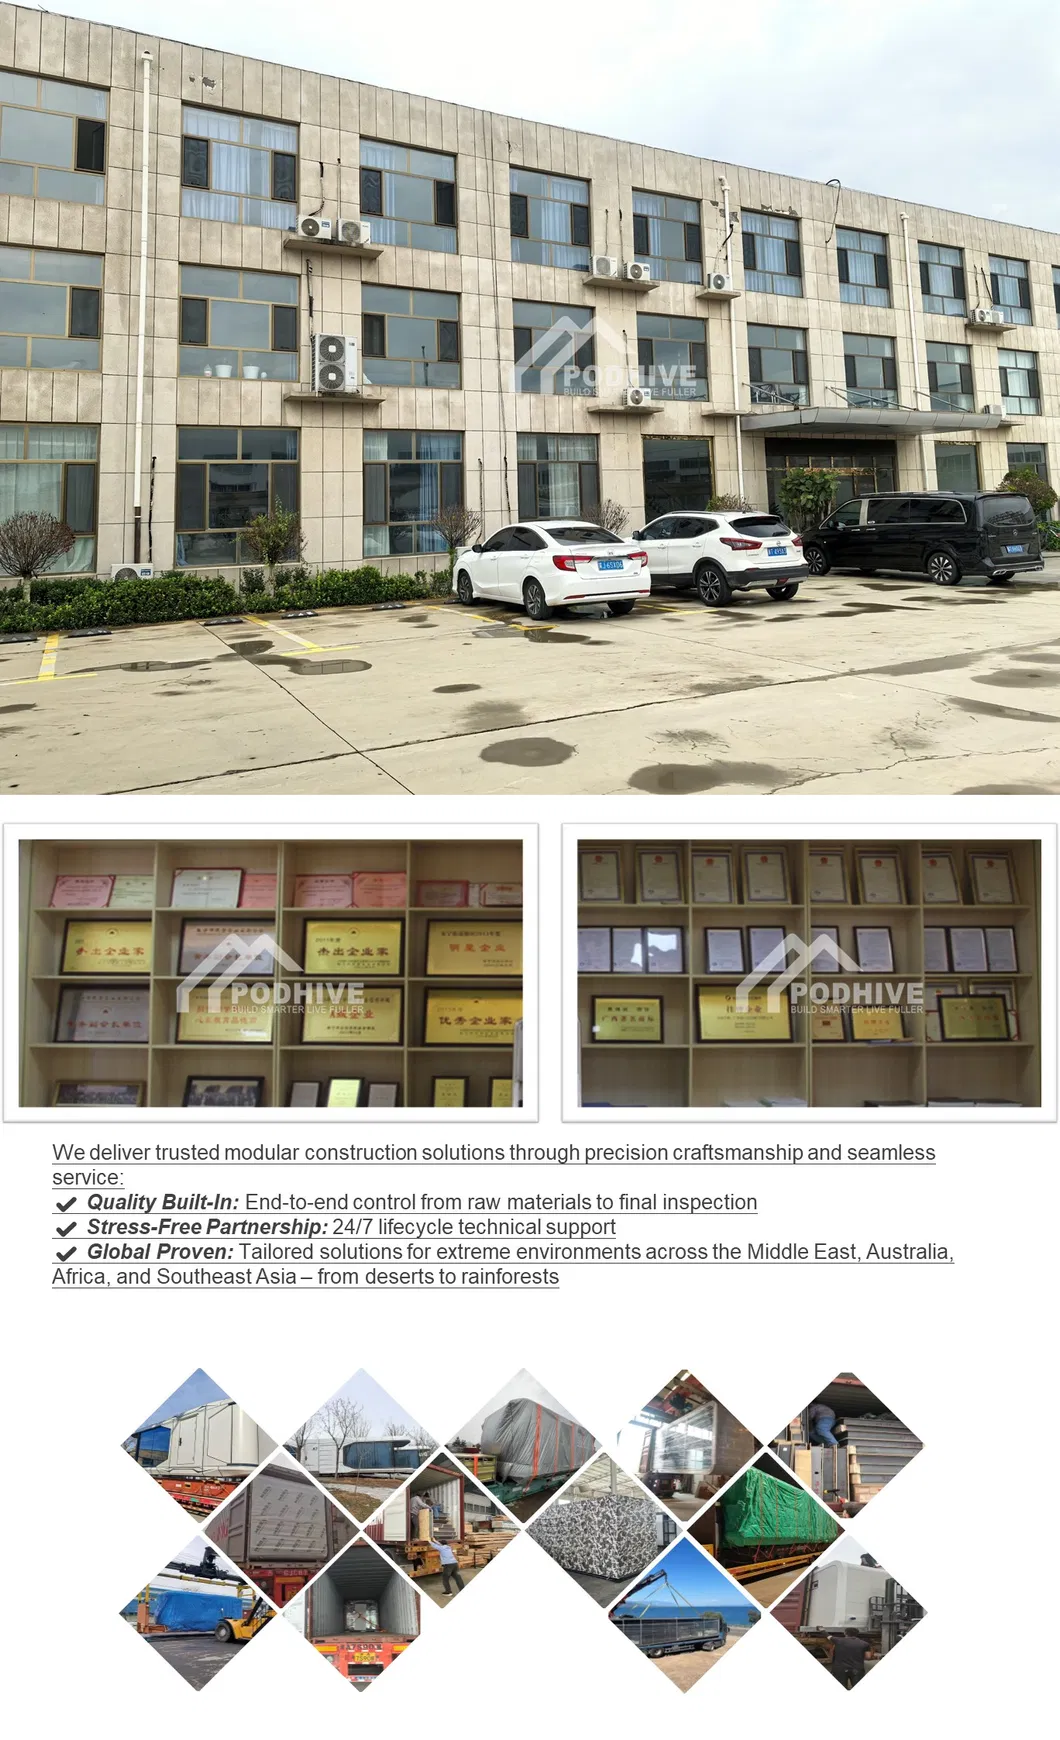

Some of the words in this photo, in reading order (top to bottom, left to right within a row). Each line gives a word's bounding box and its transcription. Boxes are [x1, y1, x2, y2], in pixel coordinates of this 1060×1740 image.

[317, 946, 389, 957] 杰出企业家
